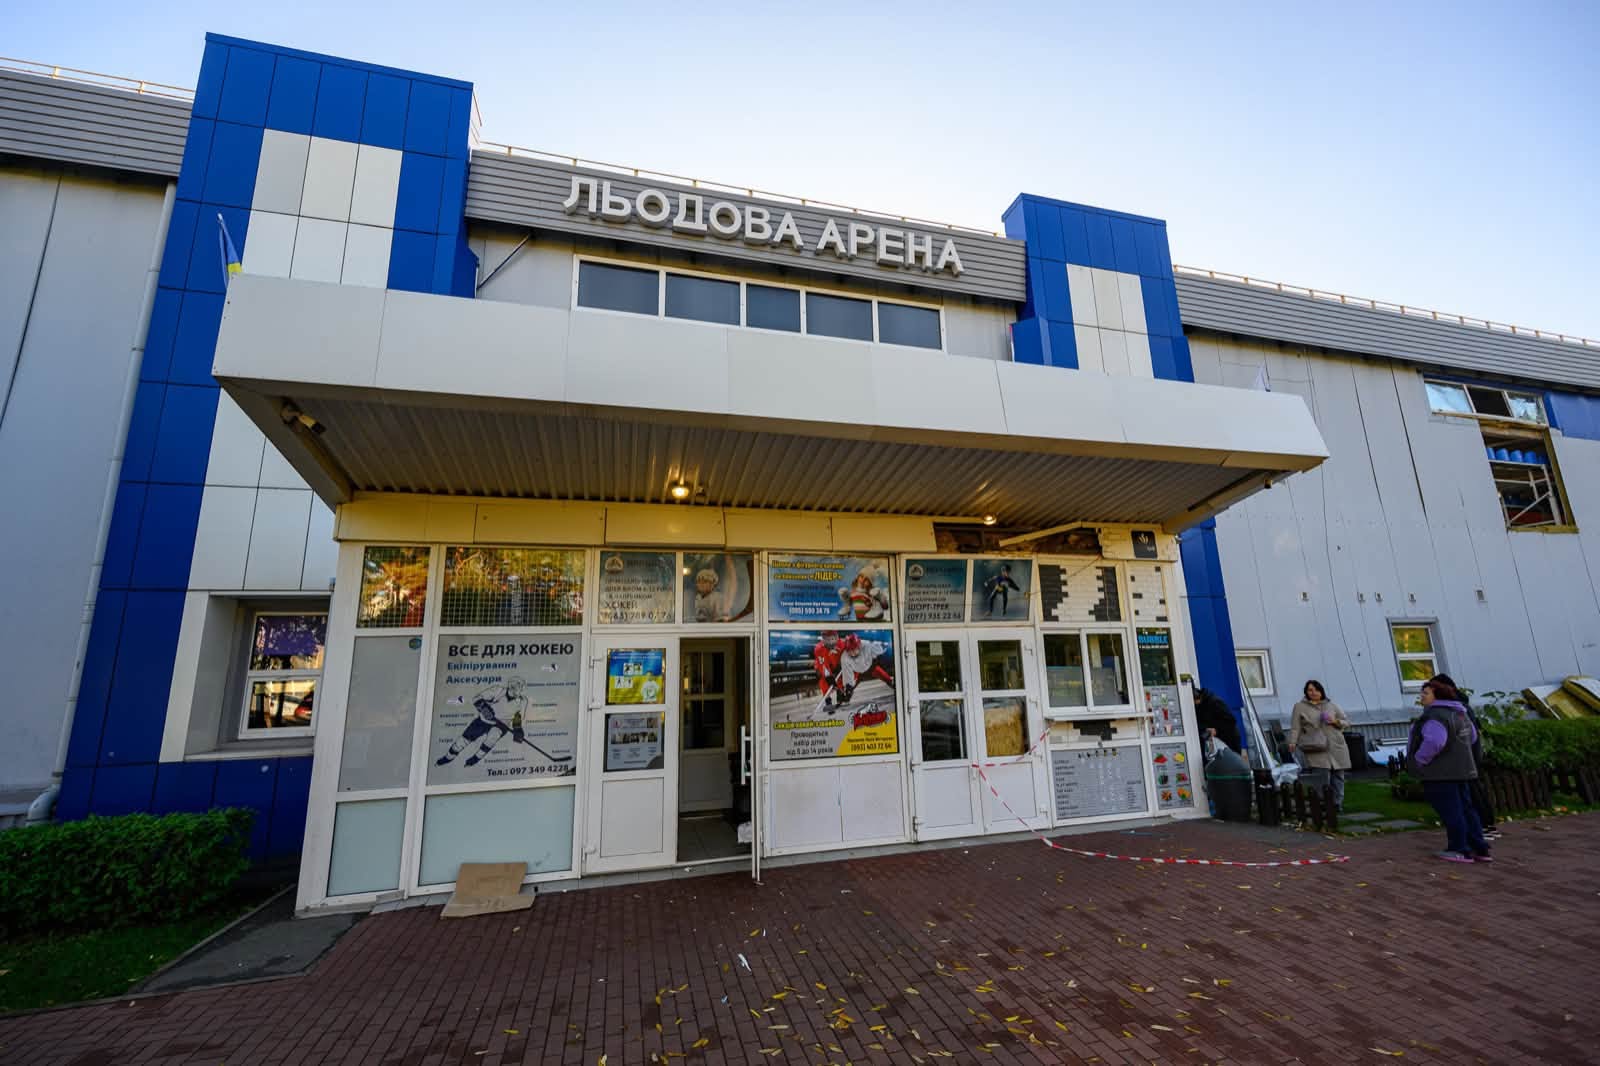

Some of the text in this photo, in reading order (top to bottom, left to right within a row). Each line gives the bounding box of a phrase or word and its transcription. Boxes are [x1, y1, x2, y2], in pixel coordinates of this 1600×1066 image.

[563, 176, 966, 277] ЛЬОДОВА АРЕНА
[448, 643, 574, 658] ВСЕ ДЛЯ ХОКЕЮ
[447, 661, 518, 672] Екіпірування
[446, 674, 502, 685] Аксесуари
[510, 766, 527, 776] 097
[529, 765, 546, 774] 349
[547, 764, 569, 773] 4228
